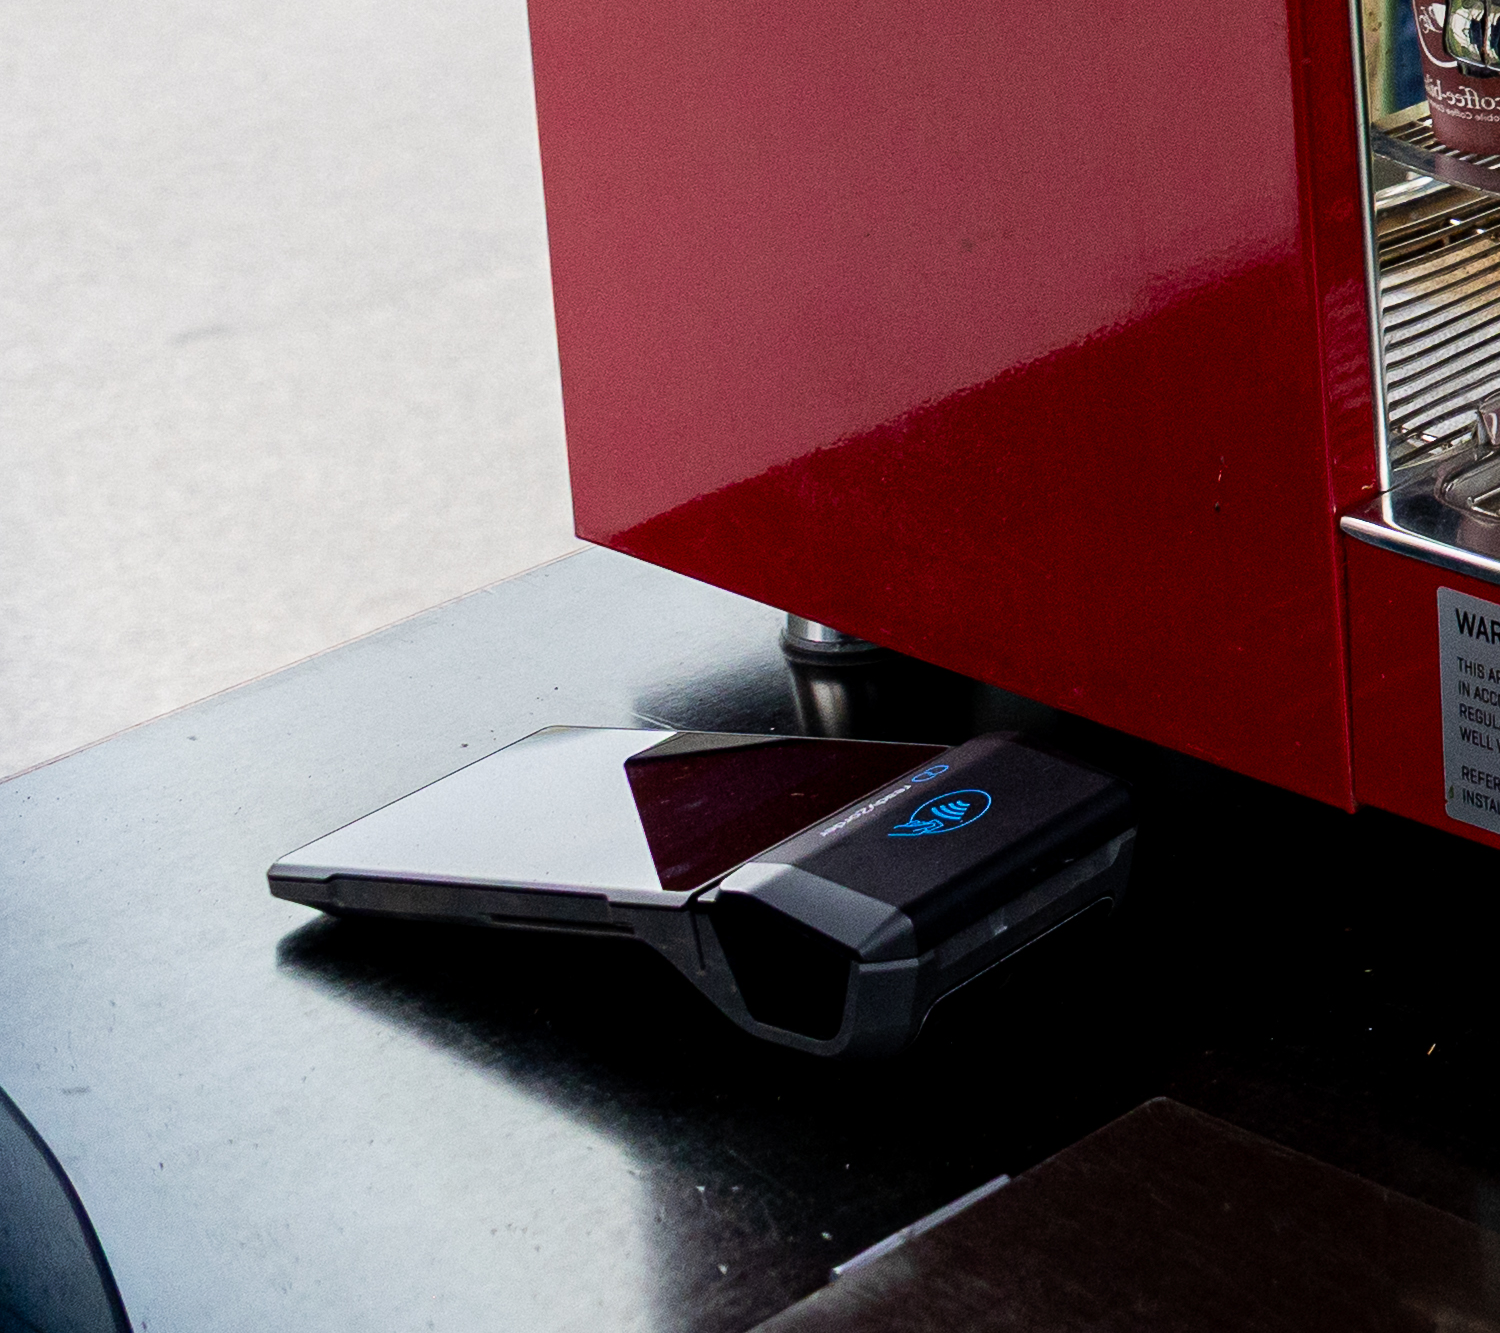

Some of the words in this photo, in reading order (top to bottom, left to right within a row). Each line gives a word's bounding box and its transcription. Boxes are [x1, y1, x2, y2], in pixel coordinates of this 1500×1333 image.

[1457, 656, 1484, 679] THIS
[1458, 680, 1470, 697] IN
[1459, 726, 1493, 751] WELL
[1462, 765, 1500, 792] REFER
